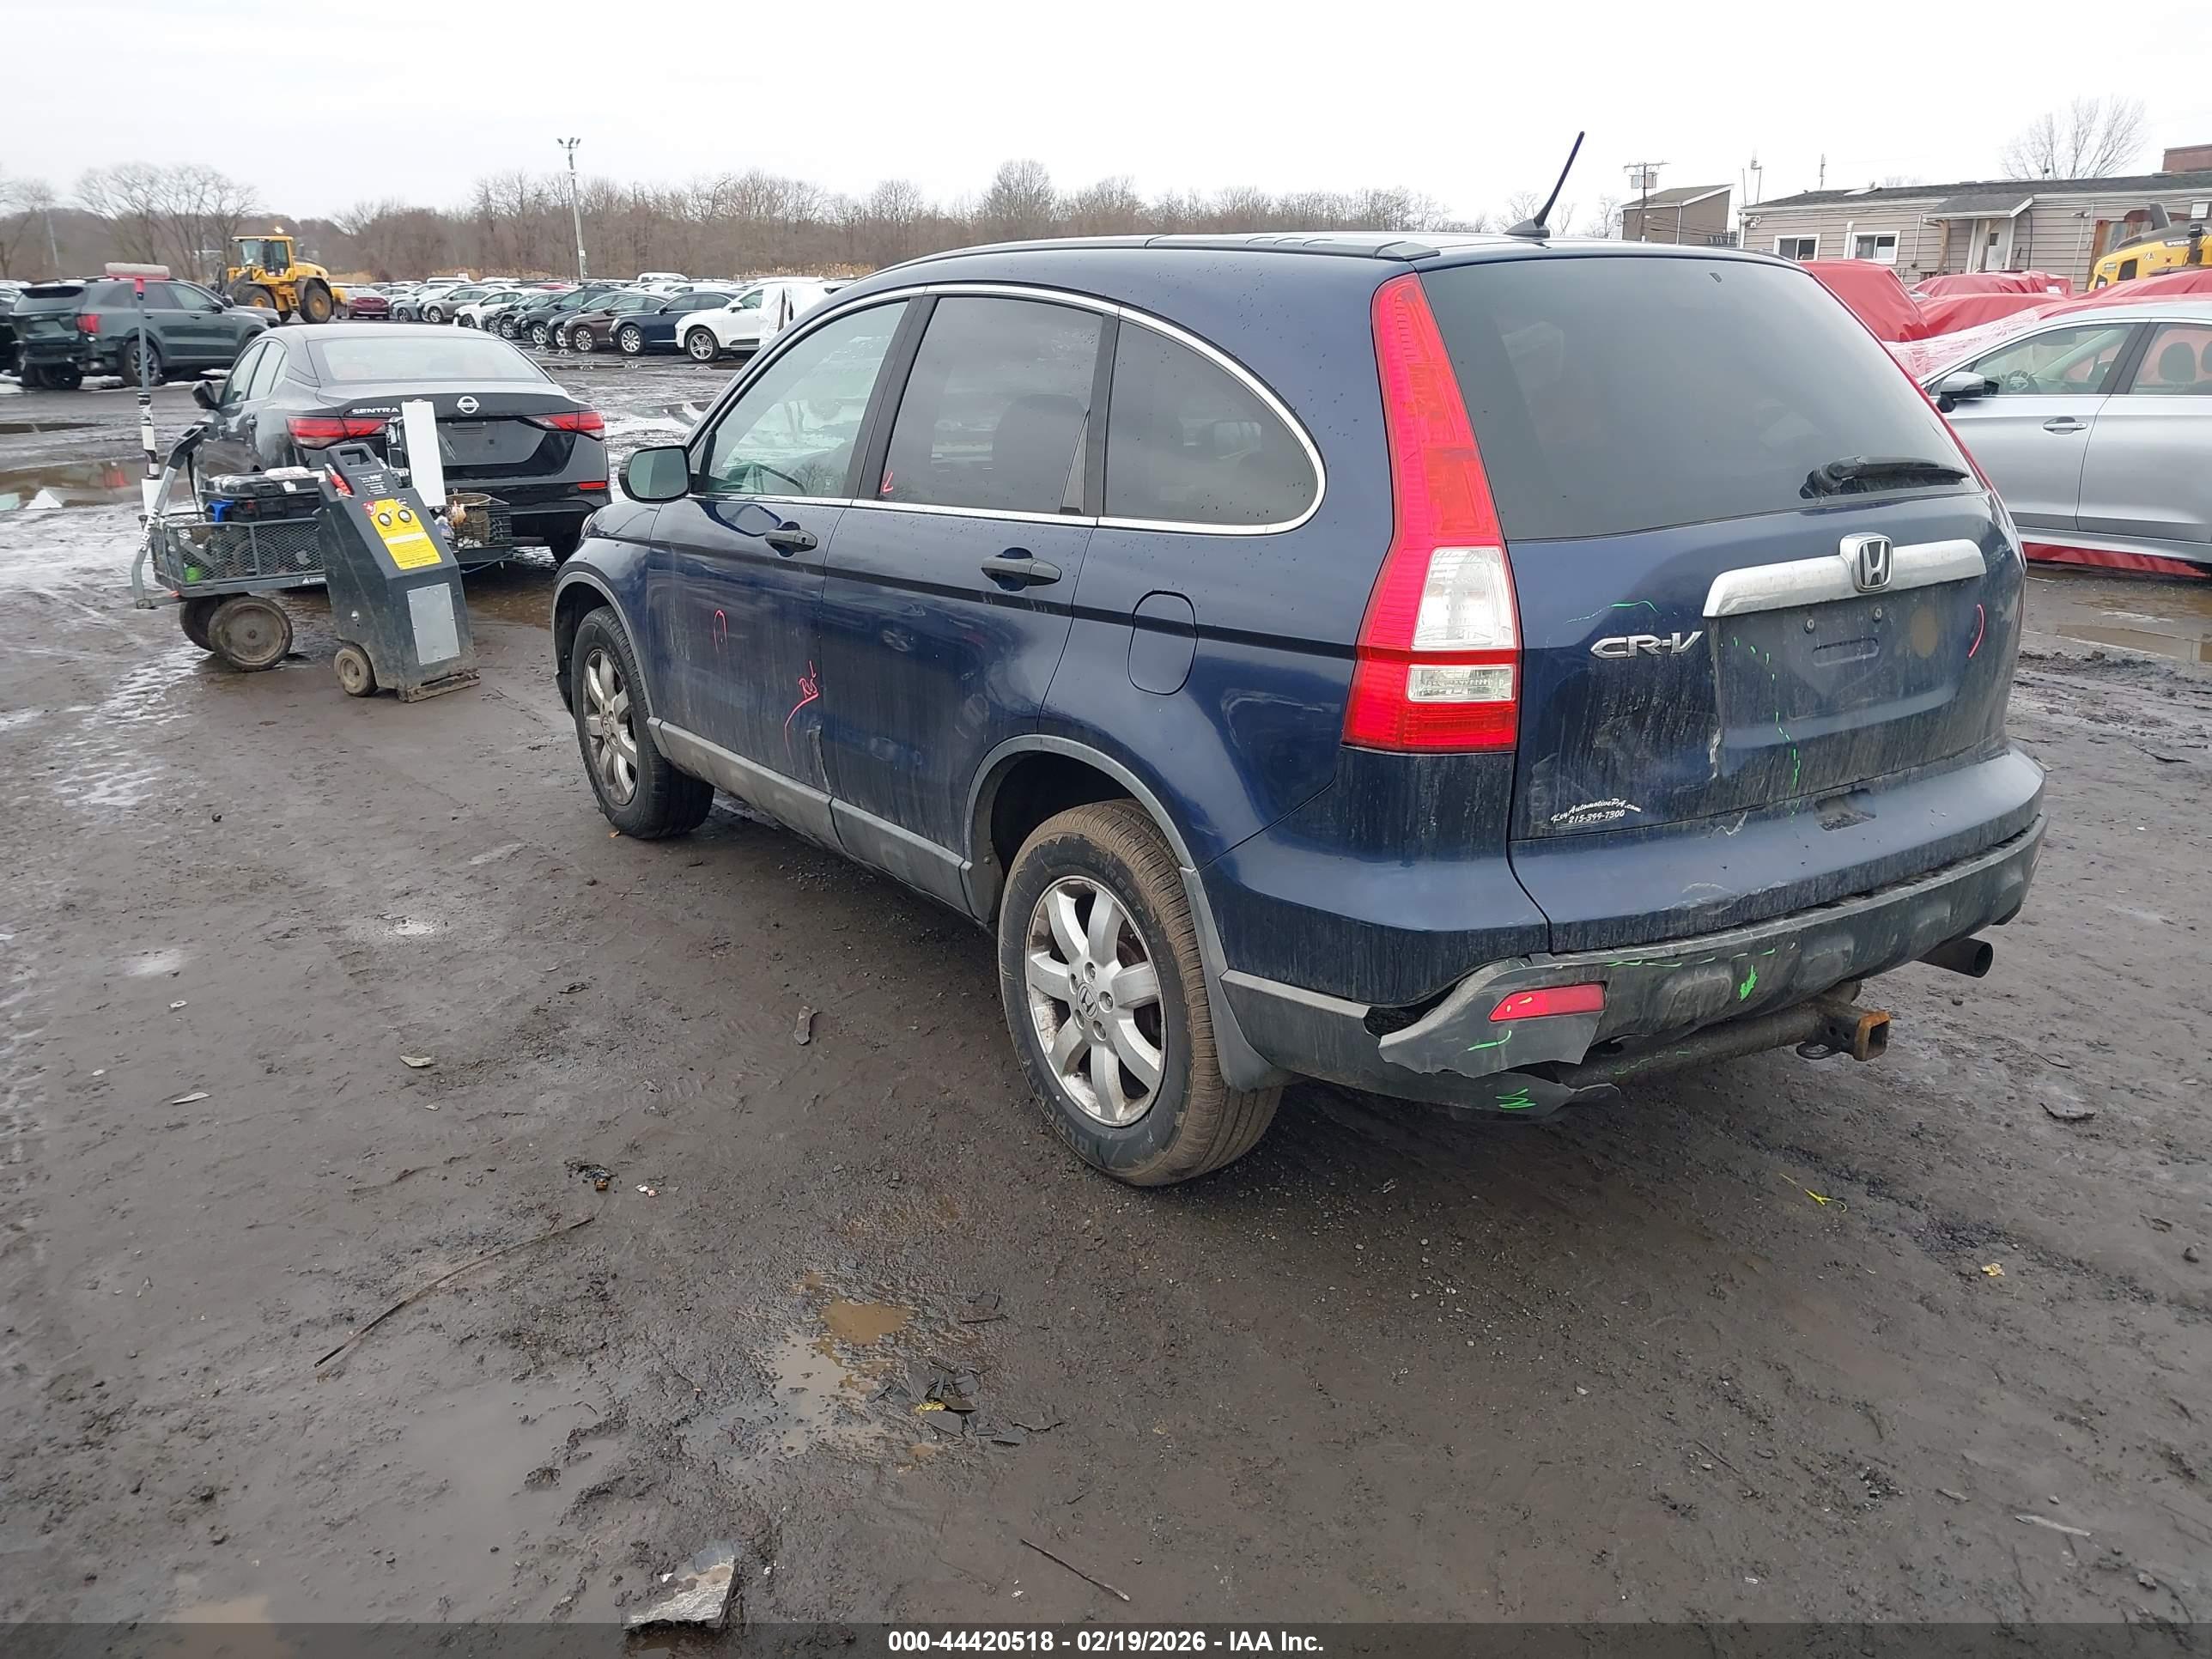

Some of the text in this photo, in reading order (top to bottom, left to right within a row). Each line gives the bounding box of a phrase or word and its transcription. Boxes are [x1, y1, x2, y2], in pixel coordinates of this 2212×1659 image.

[1590, 631, 1704, 659] CR-V
[1551, 798, 1642, 824] KeyAutomotivePA.com
[1569, 810, 1626, 823] 215-399-7300
